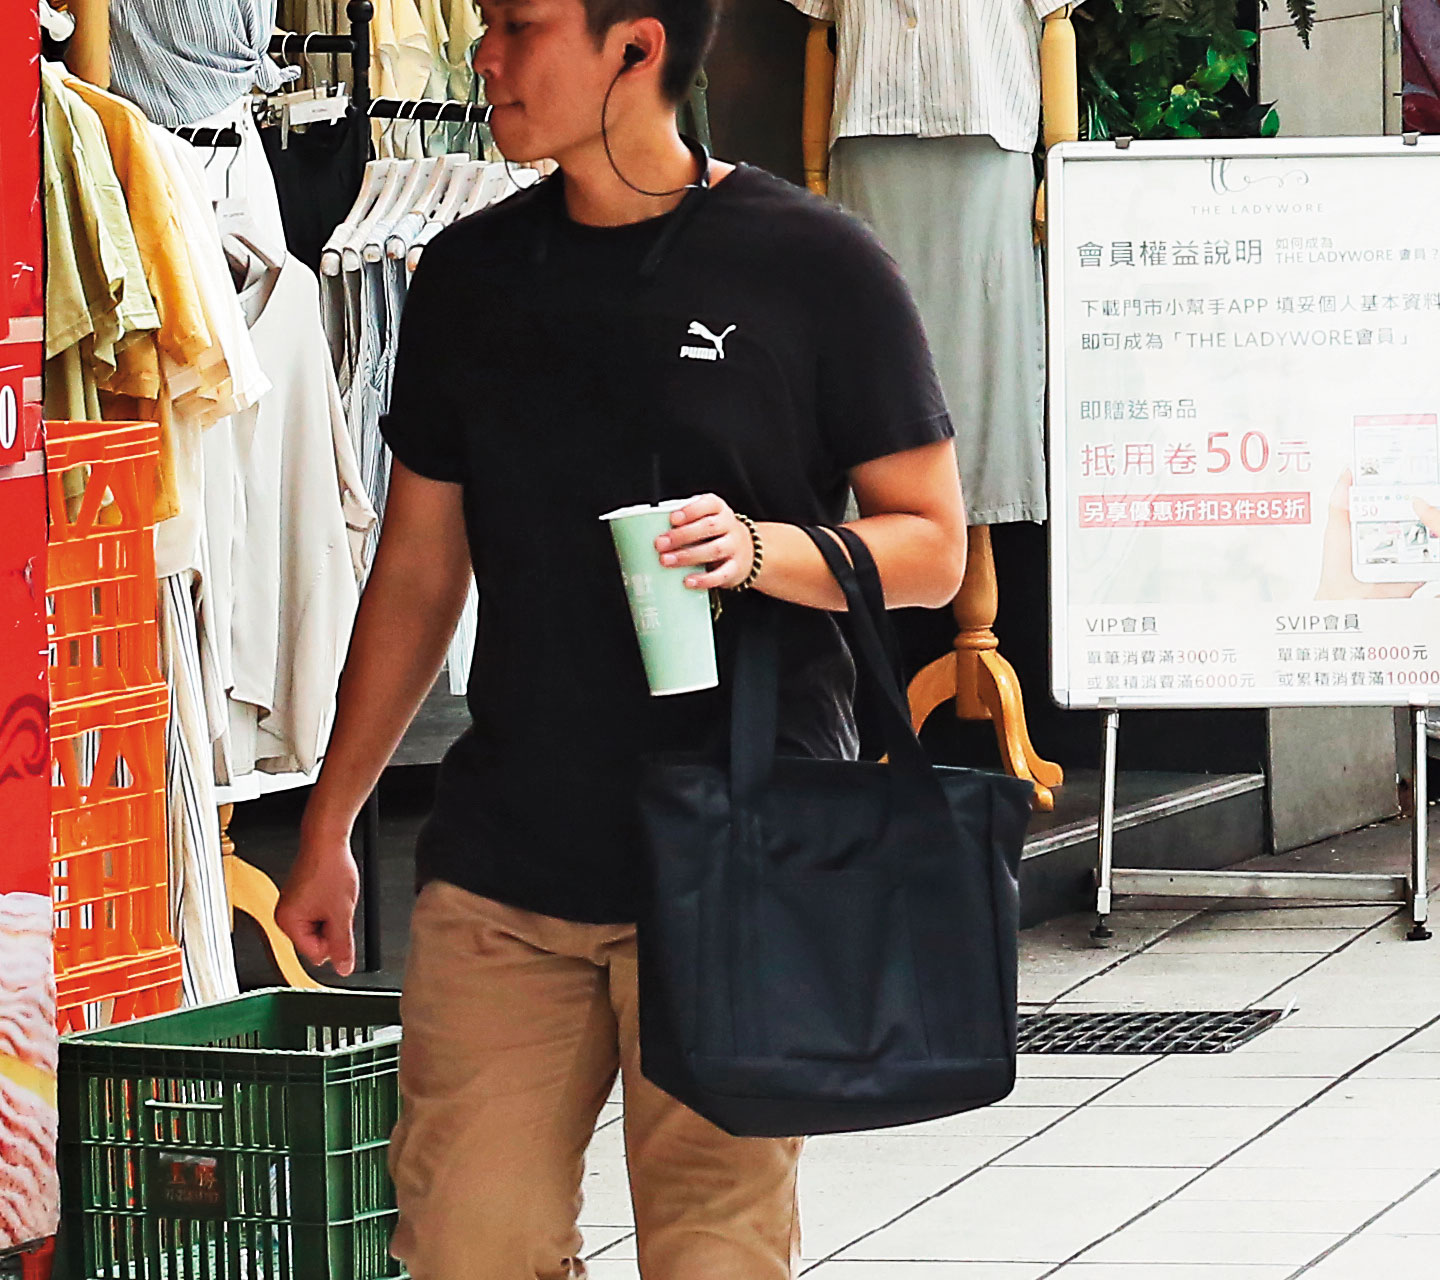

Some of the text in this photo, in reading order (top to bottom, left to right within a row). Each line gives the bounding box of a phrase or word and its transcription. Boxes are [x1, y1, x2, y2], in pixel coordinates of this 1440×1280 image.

[1191, 202, 1325, 216] THE LADYWORE
[1077, 239, 1263, 268] 會員權益說明
[1275, 237, 1334, 250] 如何成為
[1275, 251, 1303, 264] THE
[1309, 249, 1393, 263] LADYWORE
[1080, 398, 1198, 421] 即贈送商品
[1081, 430, 1312, 477] 抵用卷50元
[1083, 495, 1306, 523] 另享優惠折扣3件85折
[1085, 613, 1361, 634] VIP會員 SVIP會員
[1087, 644, 1428, 665] 單筆消費滿3000元 單筆消費滿8000元
[1087, 672, 1256, 690] 或累積消費滿6000元
